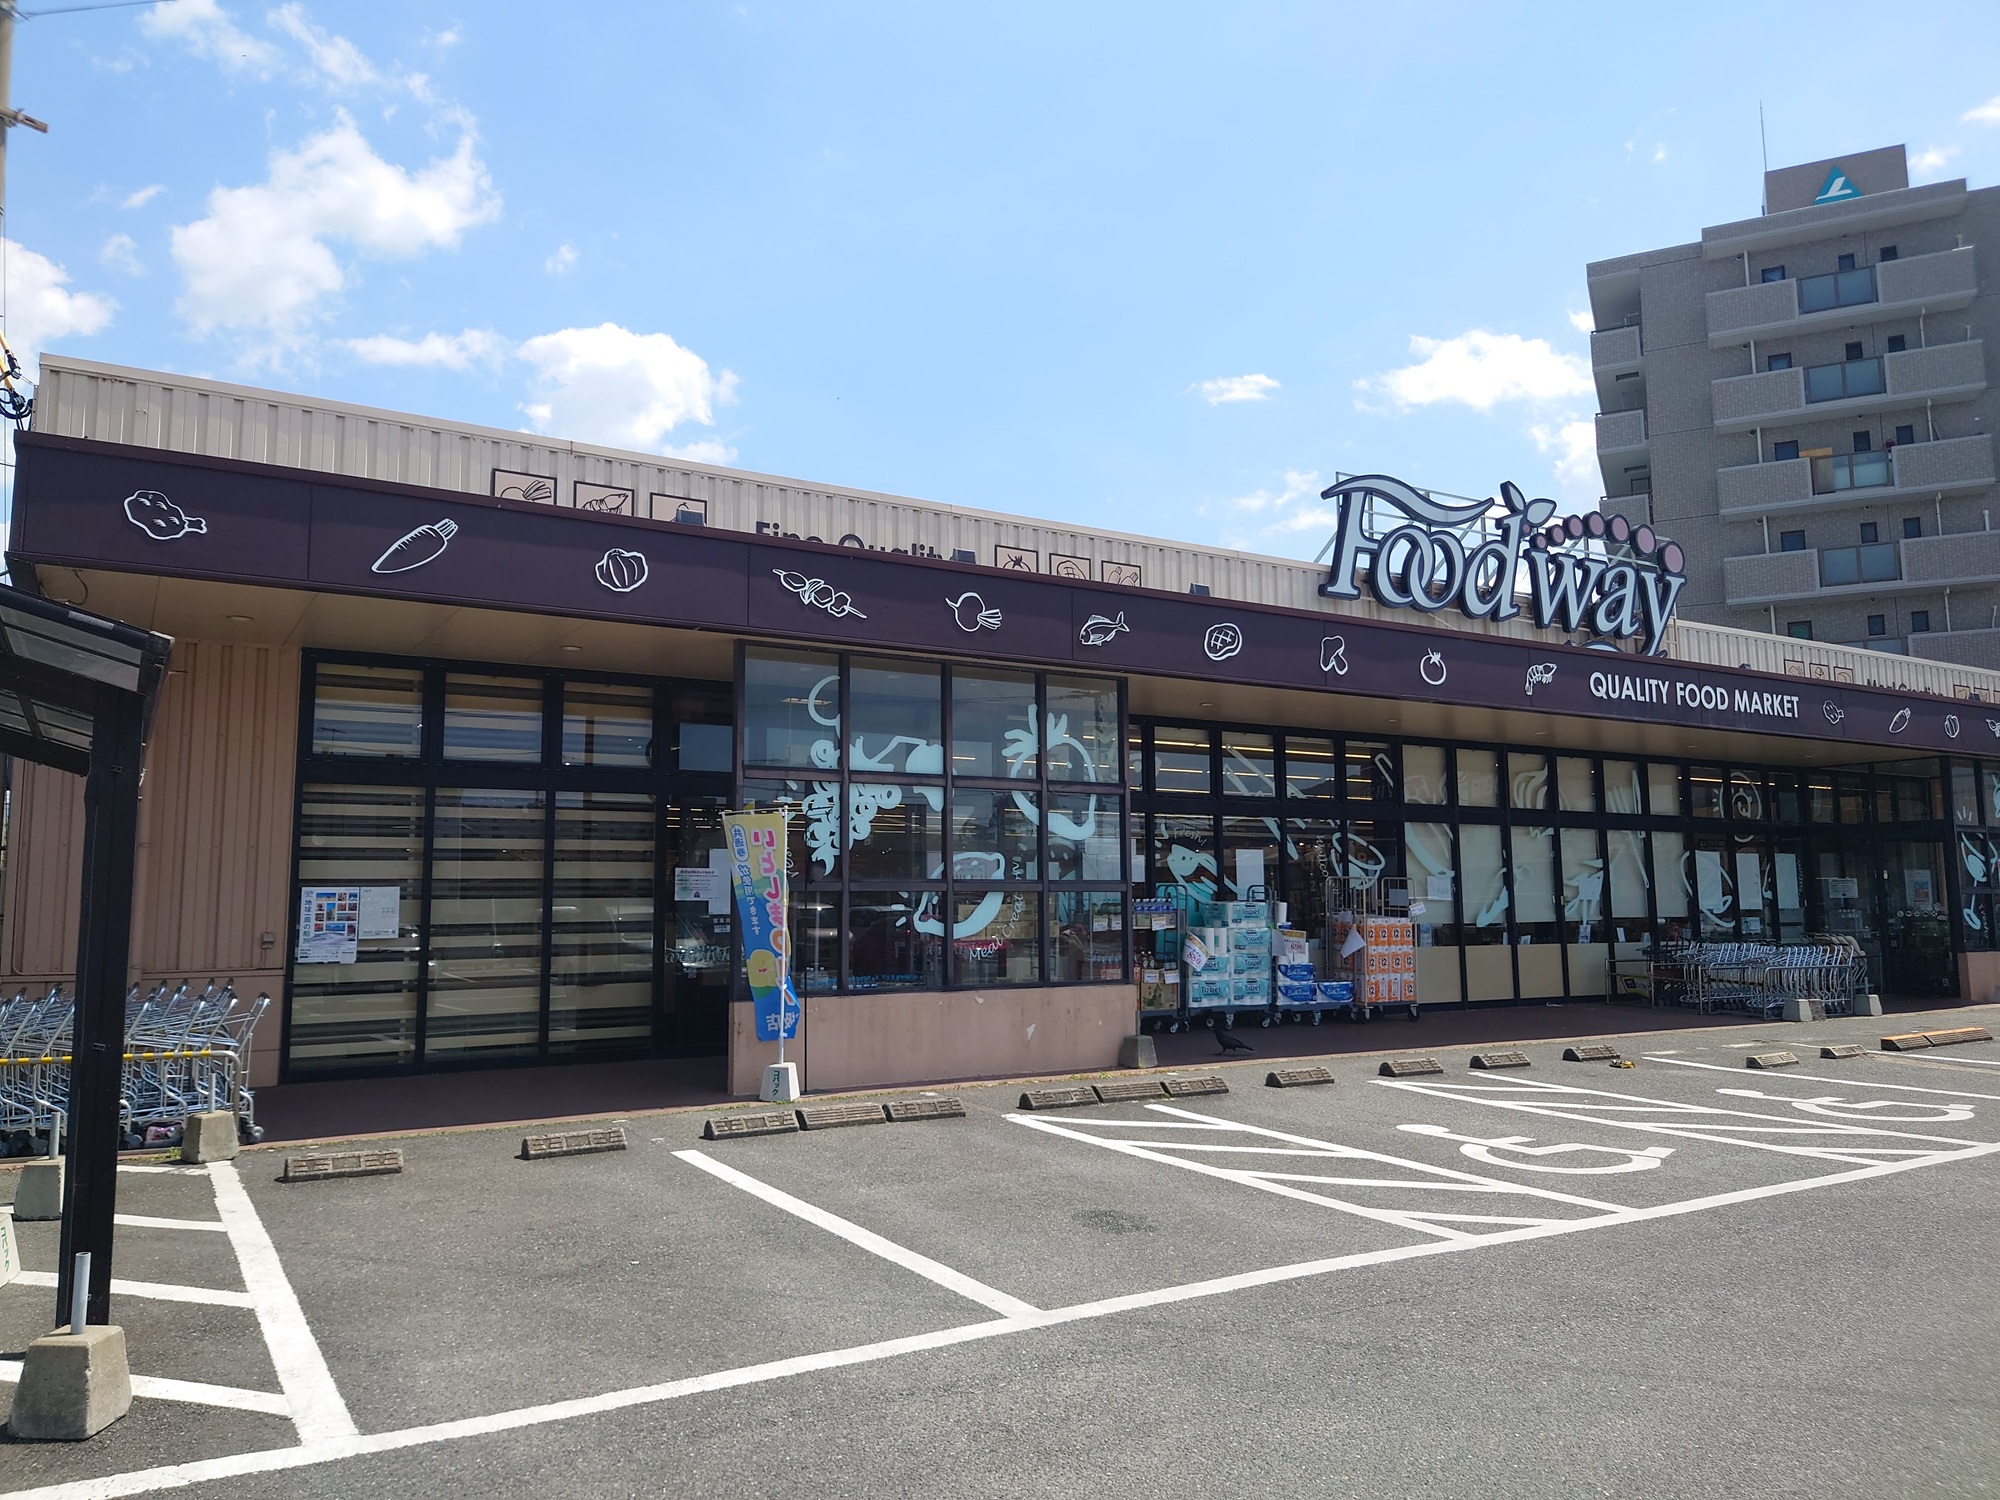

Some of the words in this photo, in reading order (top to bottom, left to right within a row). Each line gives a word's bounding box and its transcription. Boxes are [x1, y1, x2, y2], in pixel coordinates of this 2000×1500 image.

[1318, 474, 1687, 657] Foodway
[1589, 671, 1669, 704] QUALITY
[1676, 682, 1728, 710] FOOD
[1734, 689, 1799, 718] MARKET
